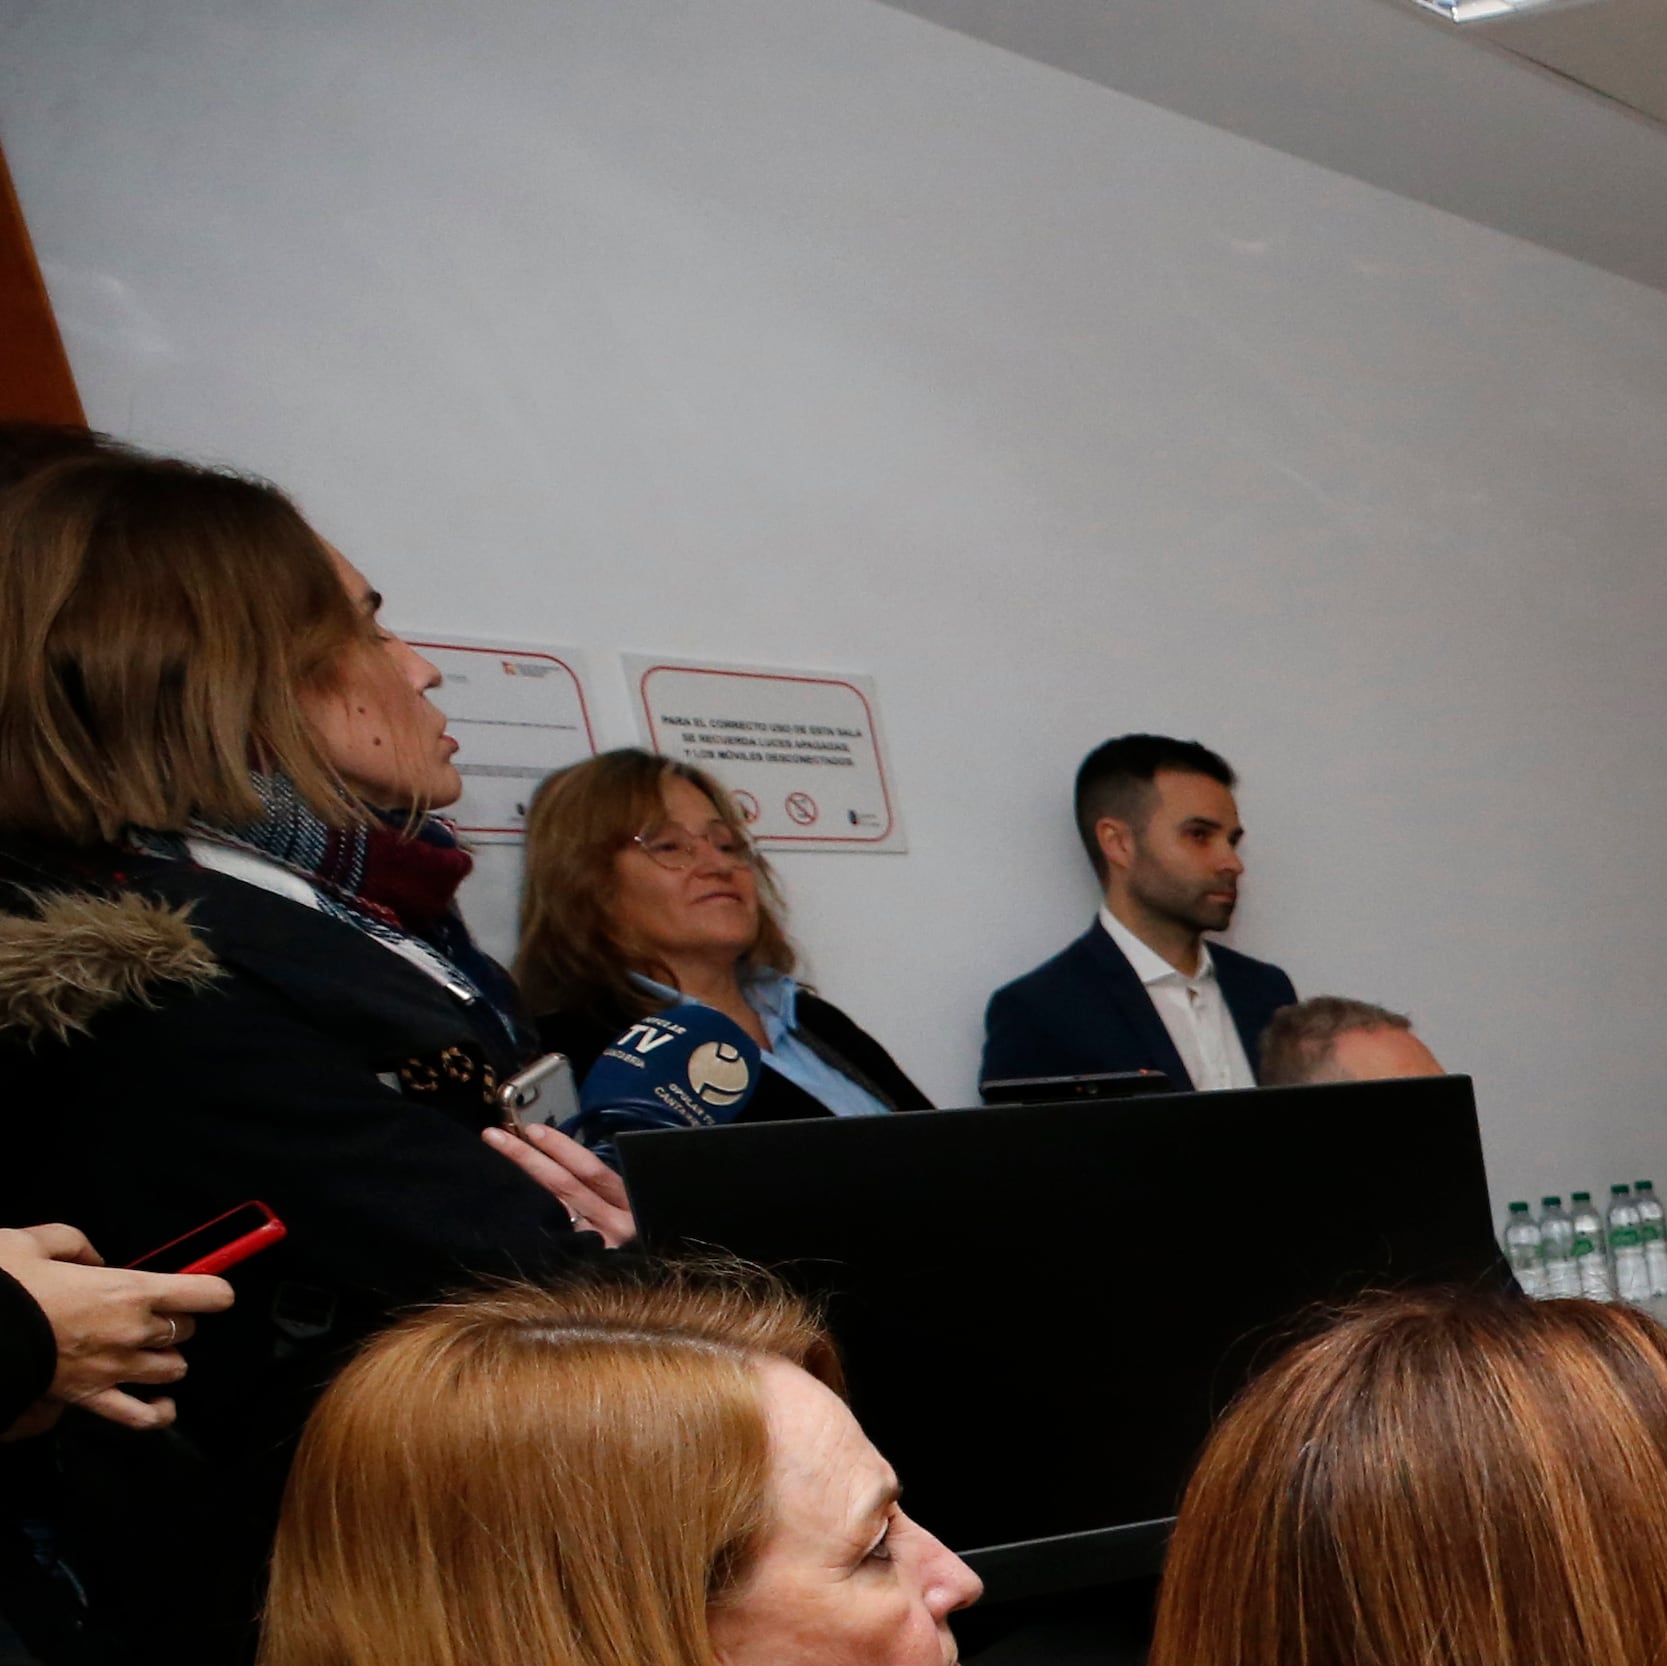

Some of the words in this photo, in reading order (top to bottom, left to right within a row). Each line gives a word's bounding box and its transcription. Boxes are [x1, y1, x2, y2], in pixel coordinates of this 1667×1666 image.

[661, 715, 691, 727] PARA
[693, 718, 707, 728] EL
[709, 719, 767, 732] CORRECTO
[770, 723, 791, 733] USO
[793, 724, 807, 734] DE
[809, 725, 835, 736] ESTA
[837, 727, 863, 738] SALA
[682, 733, 697, 743] SE
[699, 734, 757, 746] RECUERDA
[759, 738, 793, 748] LUCES
[795, 740, 851, 752] APAGADAS
[718, 749, 764, 761] MÓVILES
[765, 753, 855, 767] DESCONECTADOS
[616, 1024, 675, 1054] TV
